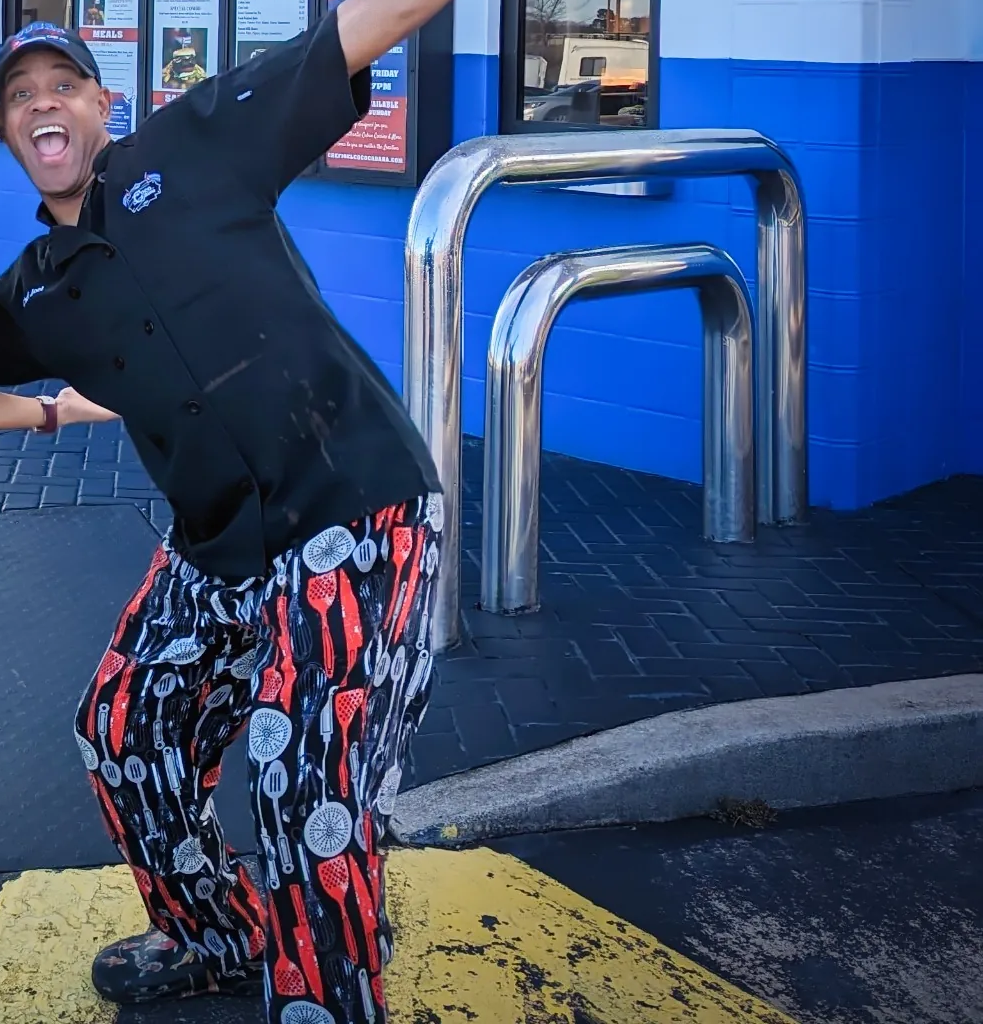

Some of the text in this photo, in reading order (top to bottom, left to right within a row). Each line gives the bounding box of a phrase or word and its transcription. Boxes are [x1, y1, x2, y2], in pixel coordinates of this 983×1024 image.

[92, 30, 124, 39] MEALS
[371, 69, 399, 77] FRIDAY
[371, 100, 399, 108] AILABLE
